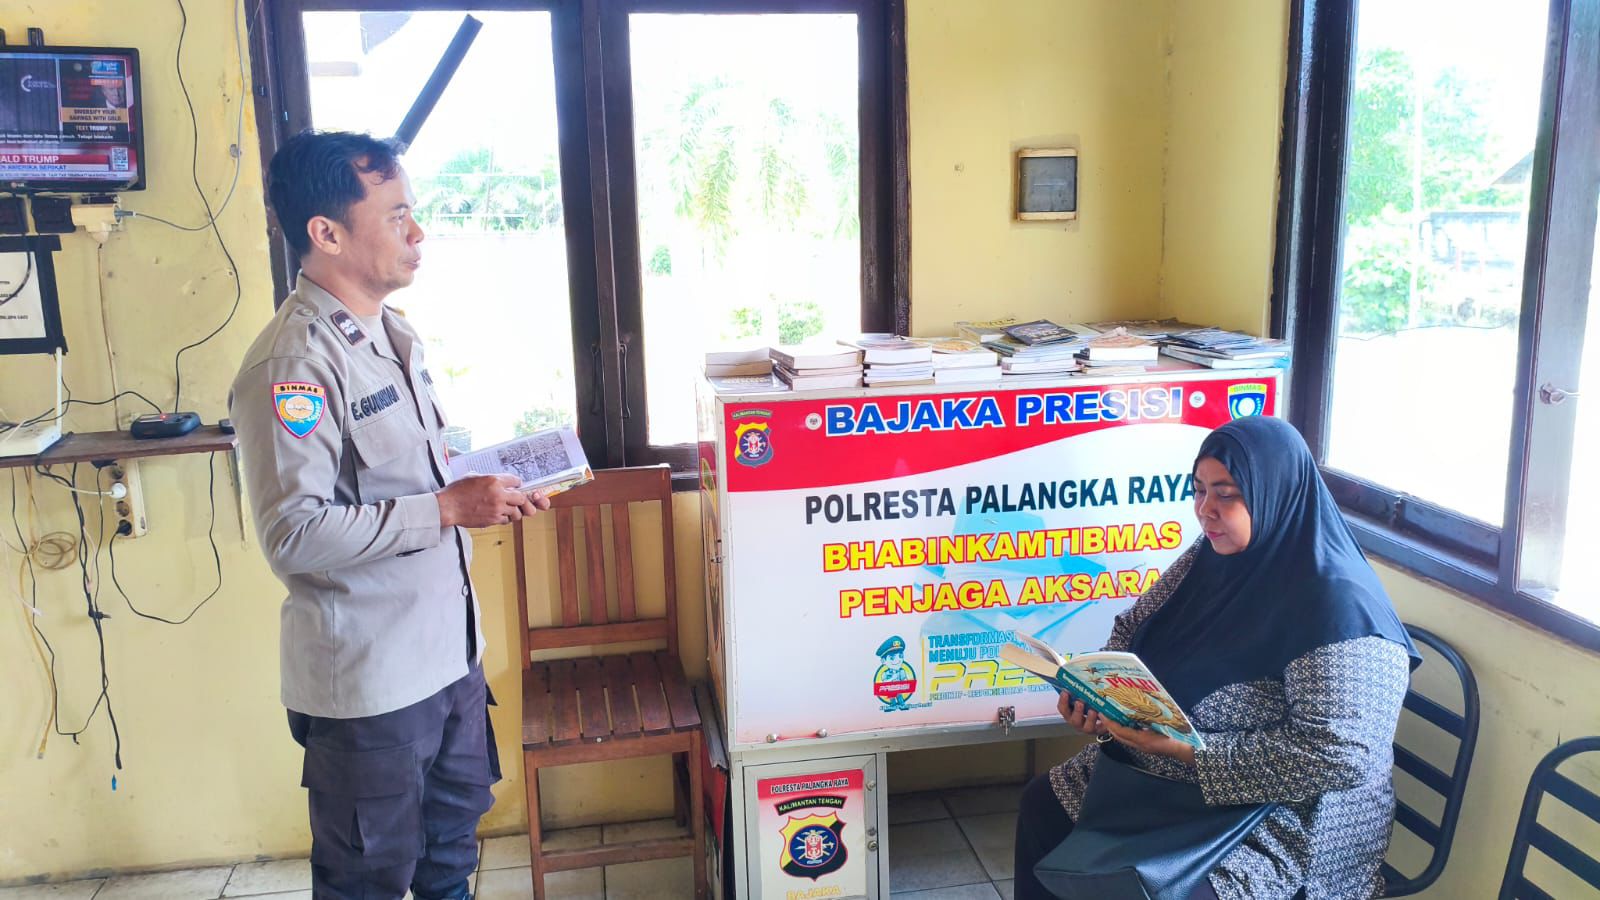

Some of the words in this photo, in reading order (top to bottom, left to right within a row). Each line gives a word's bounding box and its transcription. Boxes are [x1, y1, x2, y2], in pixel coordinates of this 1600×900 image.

[23, 155, 59, 163] TRUMP
[825, 397, 1004, 437] BAJAKA
[1016, 387, 1183, 426] PRESISI
[806, 487, 956, 524] POLRESTA
[965, 478, 1118, 514] PALANGKA
[1128, 473, 1195, 504] RAYA
[823, 521, 1183, 572] BHABINKAMTIBMAS
[840, 580, 1012, 618] PENJAGA
[1017, 568, 1161, 604] AKSARA
[928, 646, 977, 662] MENUJU
[1104, 677, 1161, 692] POLRI
[771, 784, 801, 794] POLRESTA
[801, 780, 833, 790] PALANGKA
[833, 778, 849, 787] RAYA
[778, 799, 817, 811] KALIMANTAN
